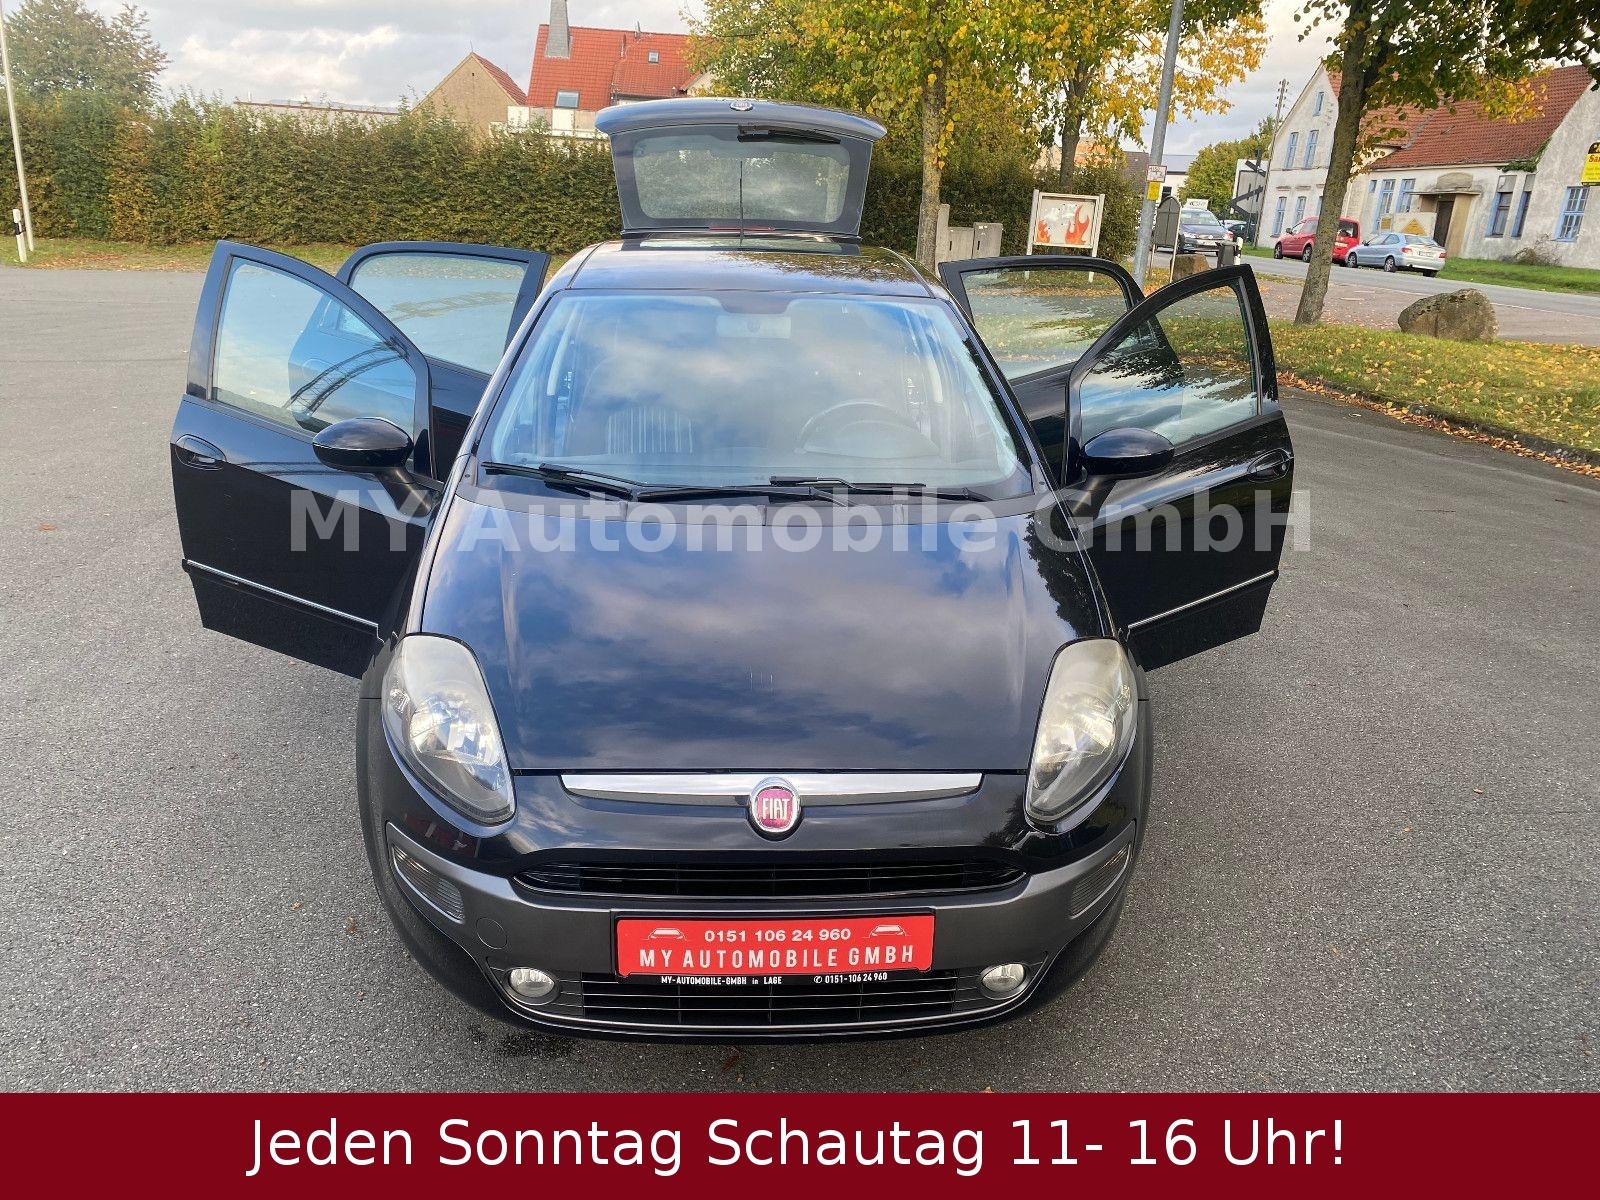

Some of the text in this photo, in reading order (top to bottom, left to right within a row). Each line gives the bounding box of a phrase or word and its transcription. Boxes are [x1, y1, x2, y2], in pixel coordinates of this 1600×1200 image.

[763, 798, 790, 820] FIAT
[704, 928, 851, 942] 0151 106 24 960
[639, 945, 914, 969] MY AUTOMOBILE GMBH
[661, 975, 747, 985] MY-AUTOMOBILE-GMBH
[763, 976, 783, 985] LAGE
